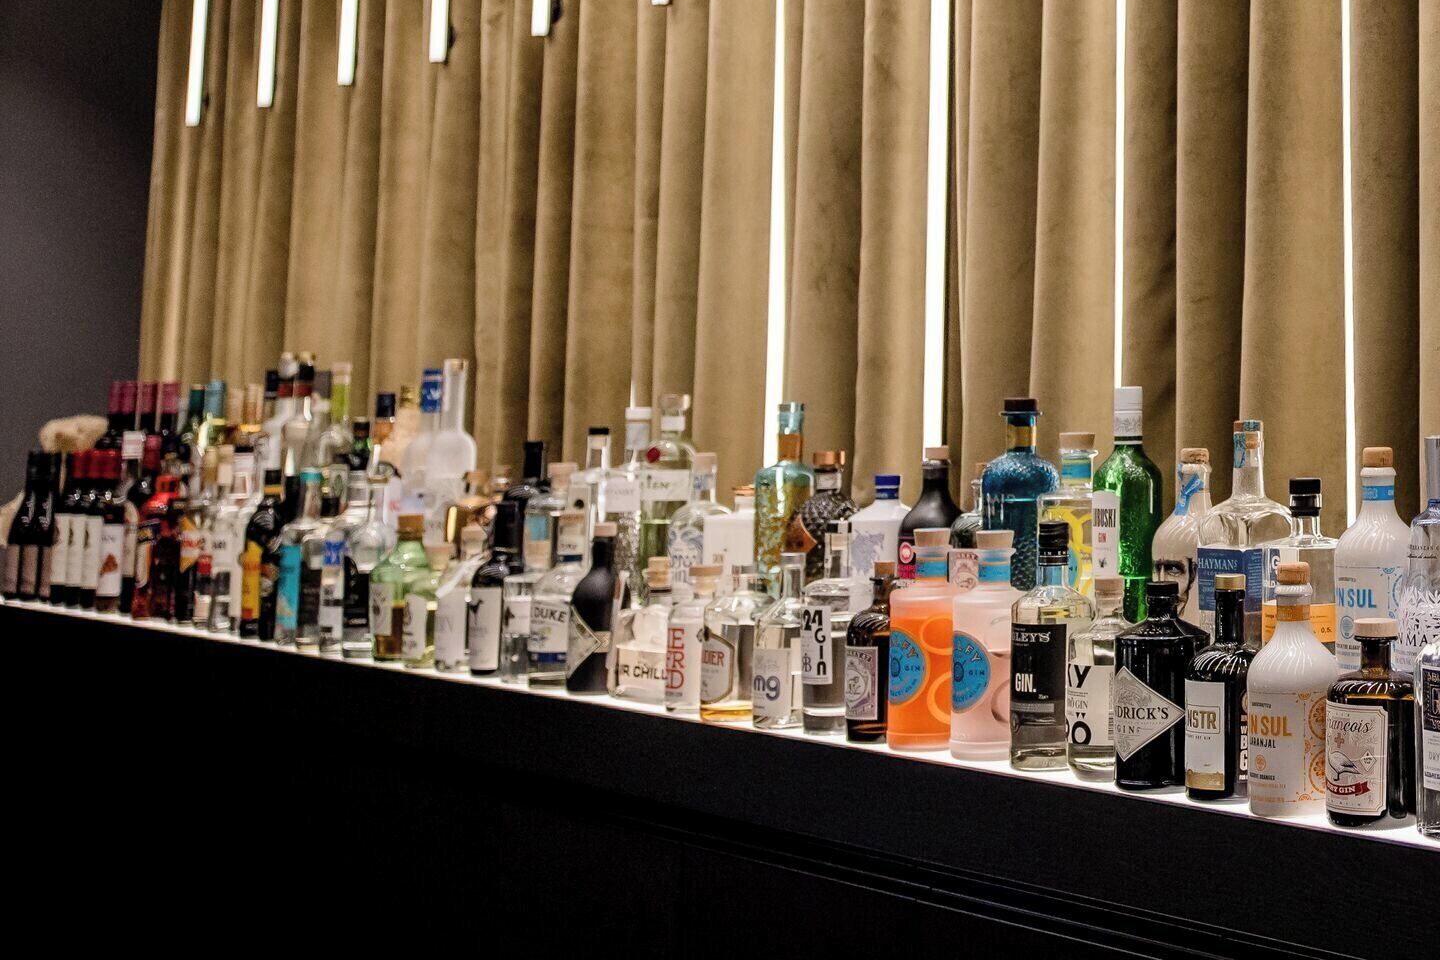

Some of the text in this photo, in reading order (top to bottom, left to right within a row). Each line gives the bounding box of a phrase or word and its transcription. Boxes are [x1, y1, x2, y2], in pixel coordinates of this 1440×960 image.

[1347, 588, 1377, 609] SUL
[1015, 672, 1037, 693] GIN.
[1261, 715, 1293, 737] SUL
